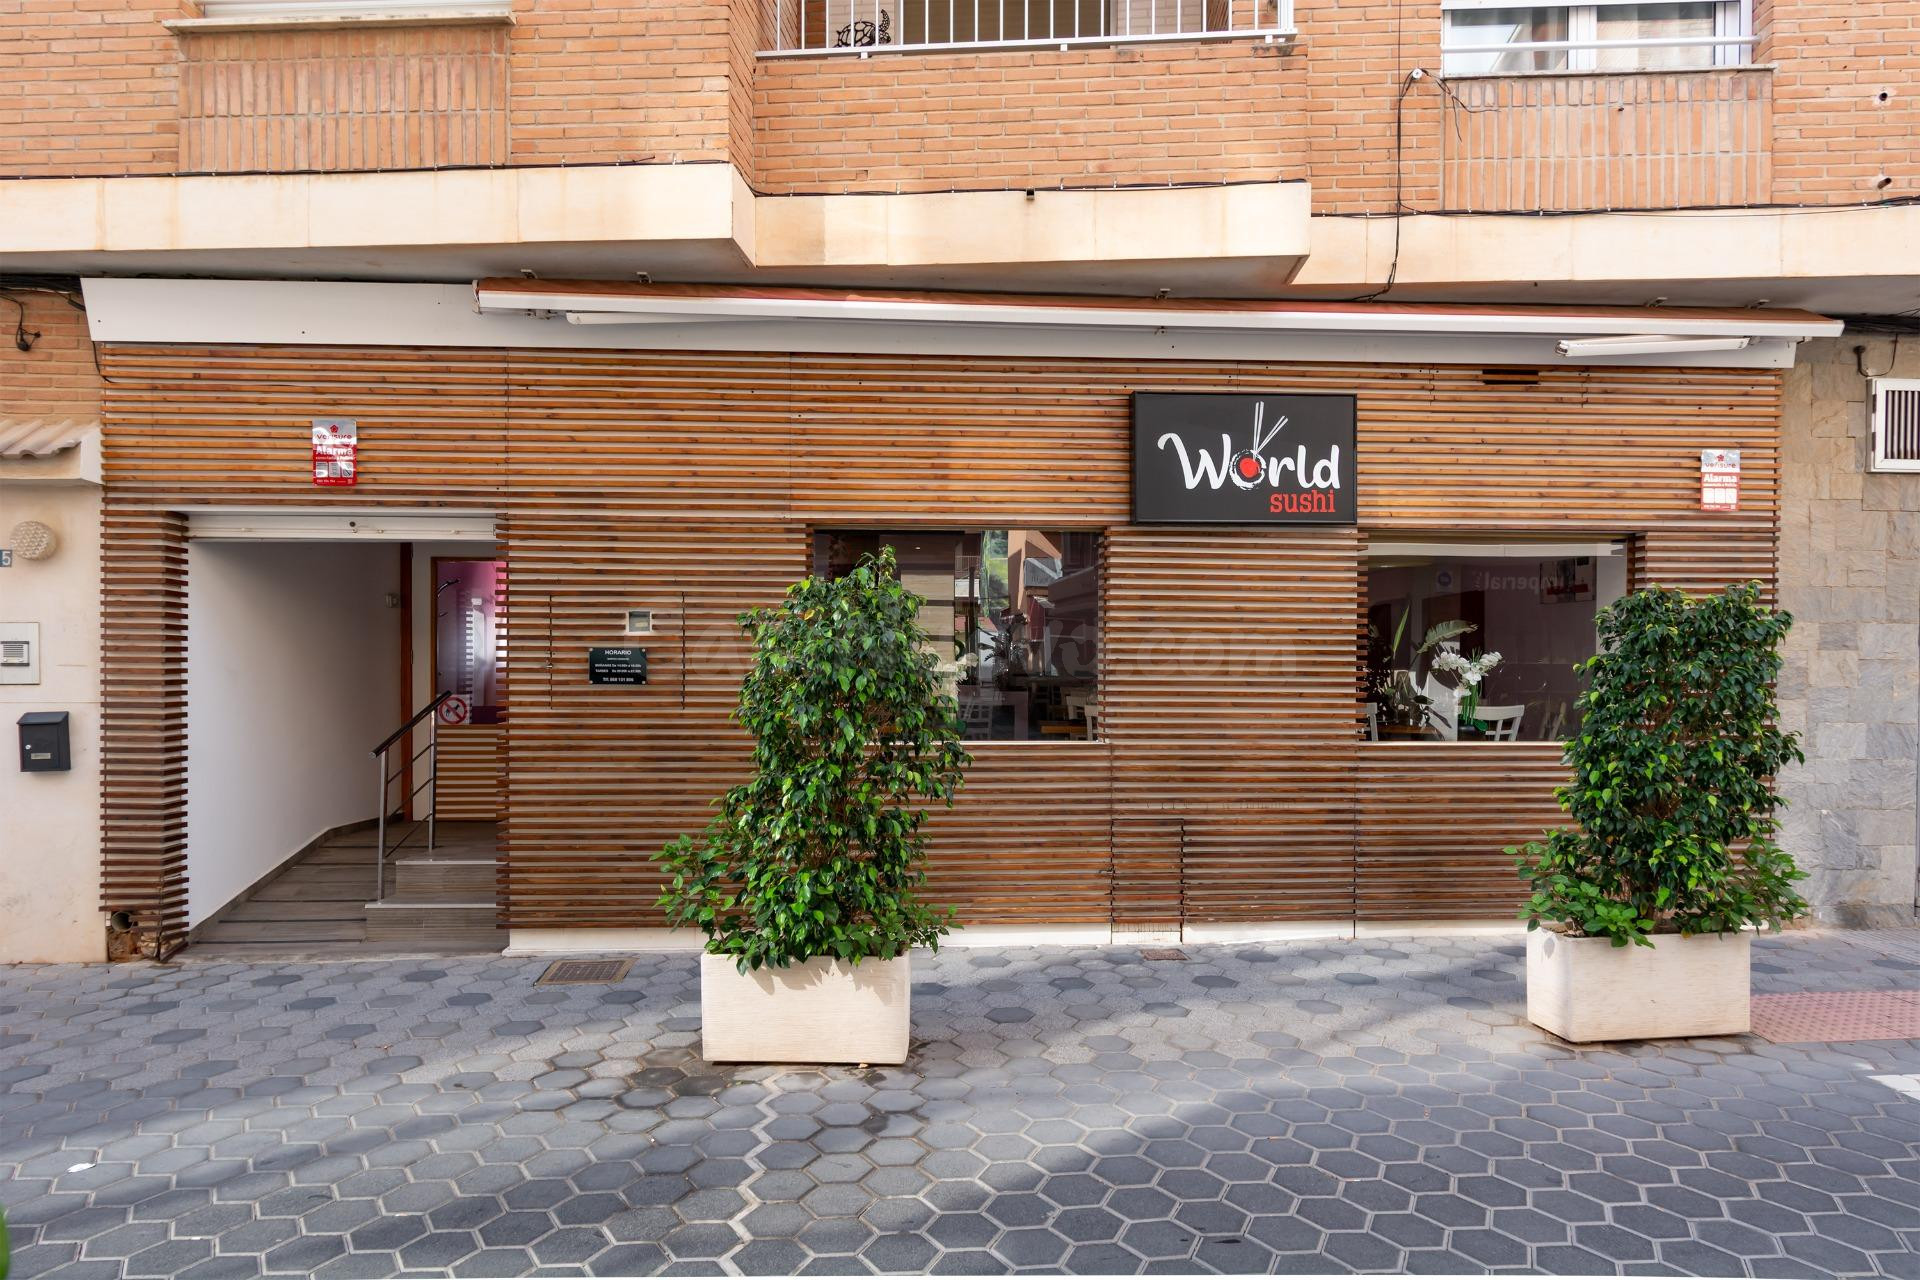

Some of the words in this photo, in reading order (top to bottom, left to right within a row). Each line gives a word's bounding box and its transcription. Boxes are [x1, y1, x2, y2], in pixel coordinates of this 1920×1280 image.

[316, 445, 353, 456] Alarma
[1157, 432, 1341, 490] World
[1703, 474, 1737, 483] Alarma
[1270, 489, 1336, 513] sushi
[2, 551, 11, 566] 5
